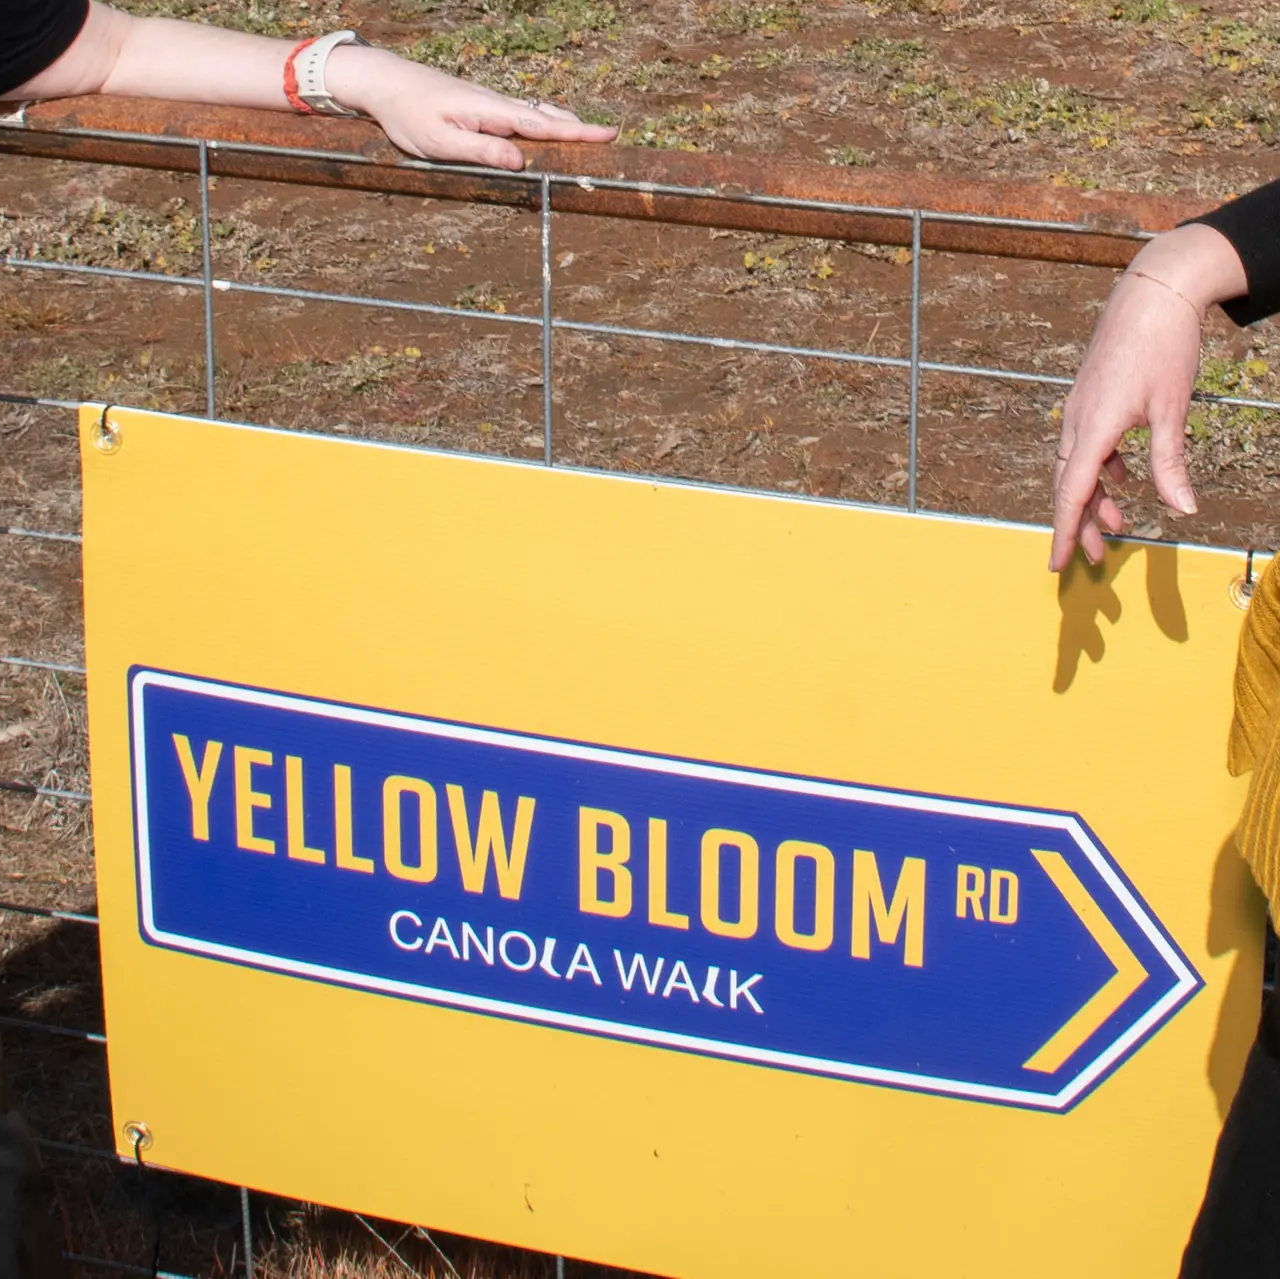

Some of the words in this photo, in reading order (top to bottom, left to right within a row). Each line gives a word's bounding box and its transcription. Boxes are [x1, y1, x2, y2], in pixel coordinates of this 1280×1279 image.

[172, 734, 535, 901] YELLOW
[579, 806, 926, 968] BLOOM
[956, 864, 1019, 925] RD
[389, 910, 602, 986] CANOLA
[613, 949, 765, 1015] WALK
